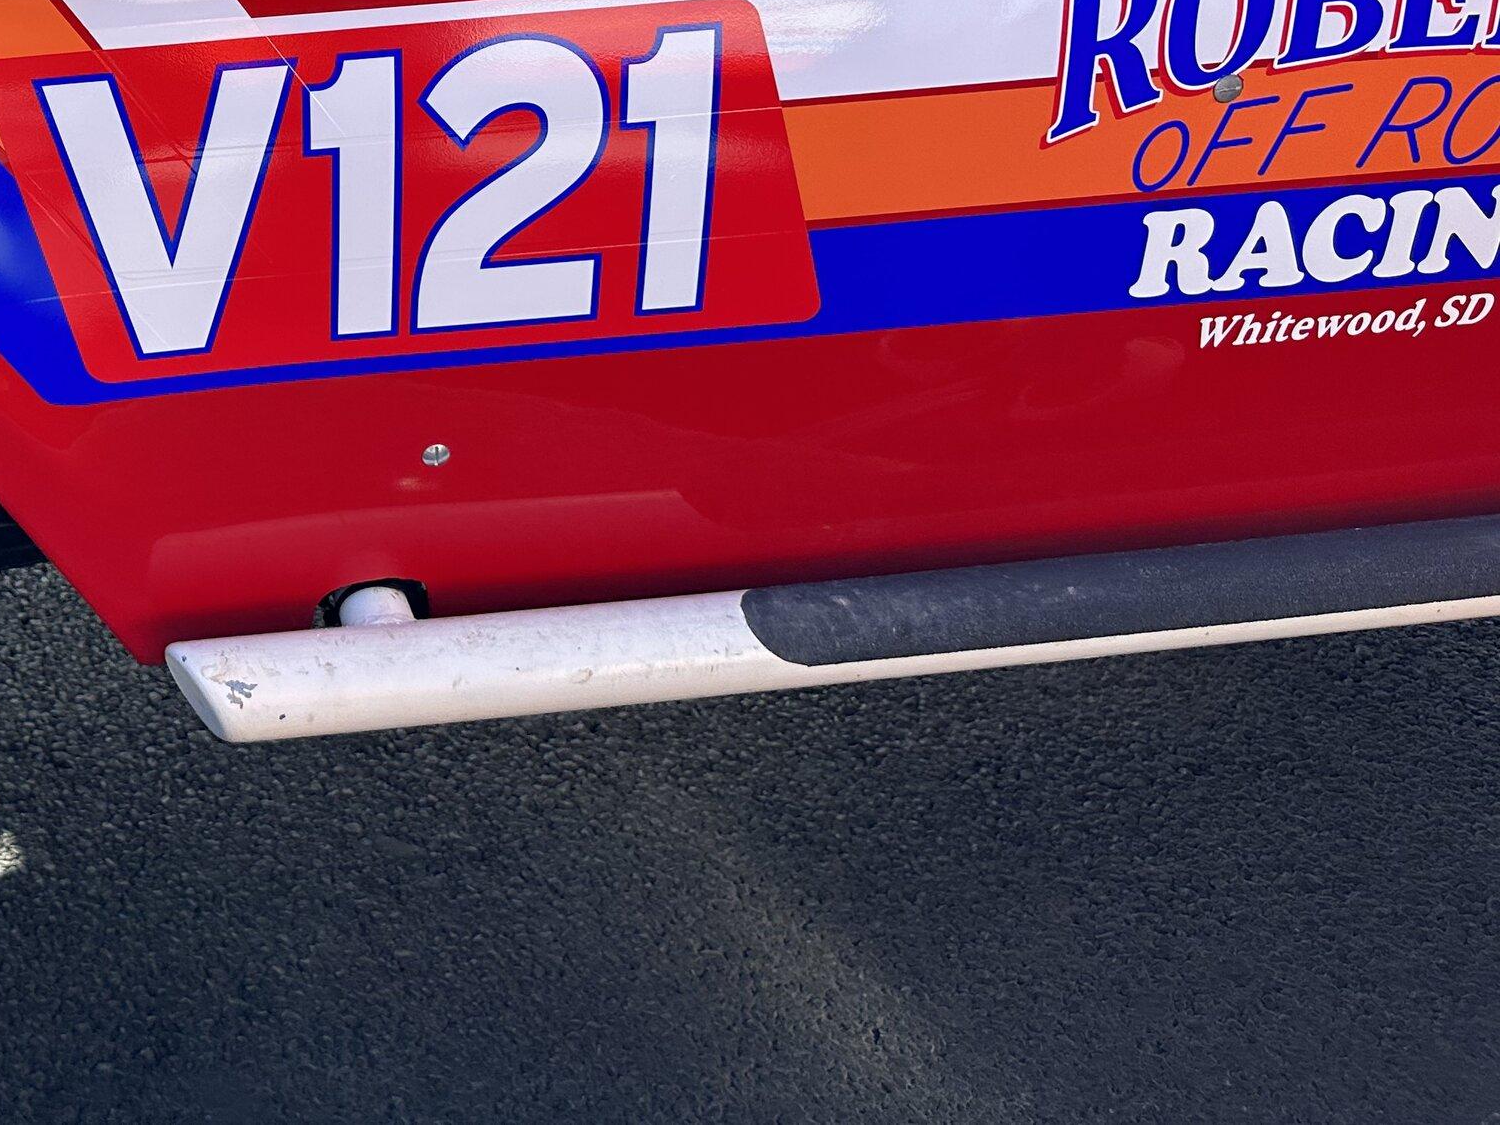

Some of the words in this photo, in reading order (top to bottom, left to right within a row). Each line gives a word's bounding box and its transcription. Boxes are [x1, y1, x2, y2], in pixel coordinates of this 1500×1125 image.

[32, 22, 724, 360] V121
[1131, 83, 1354, 193] OFF
[1199, 298, 1426, 350] Whitewood,
[1435, 292, 1496, 327] SD
